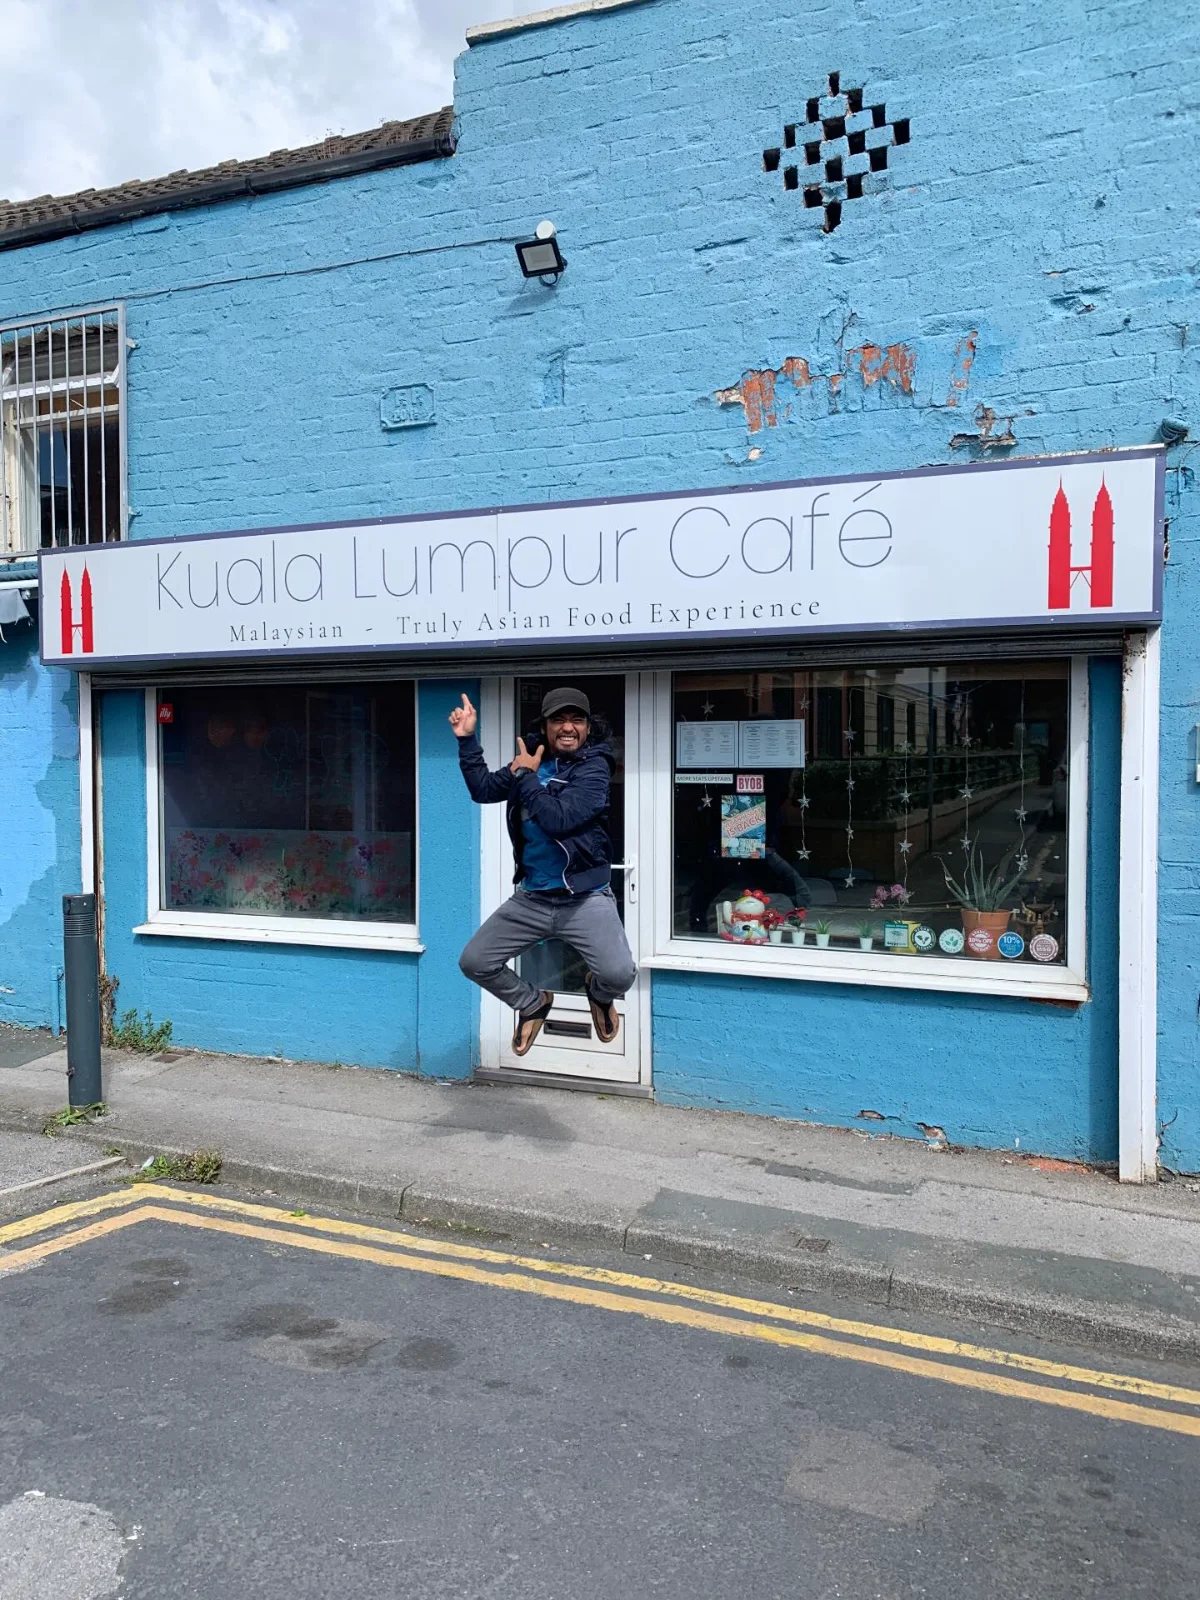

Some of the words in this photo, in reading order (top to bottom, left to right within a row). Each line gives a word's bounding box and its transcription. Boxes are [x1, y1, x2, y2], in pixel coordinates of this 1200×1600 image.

[156, 538, 324, 612] Kuala
[353, 525, 638, 614] Lumpur
[669, 481, 893, 579] Café
[230, 621, 343, 649] Malaysian
[396, 612, 463, 640] Truly
[478, 611, 551, 633] Asian
[568, 602, 633, 627] Food
[649, 600, 820, 630] Experience
[159, 707, 172, 720] illy
[738, 777, 762, 790] BYOB
[1003, 936, 1021, 944] 10%
